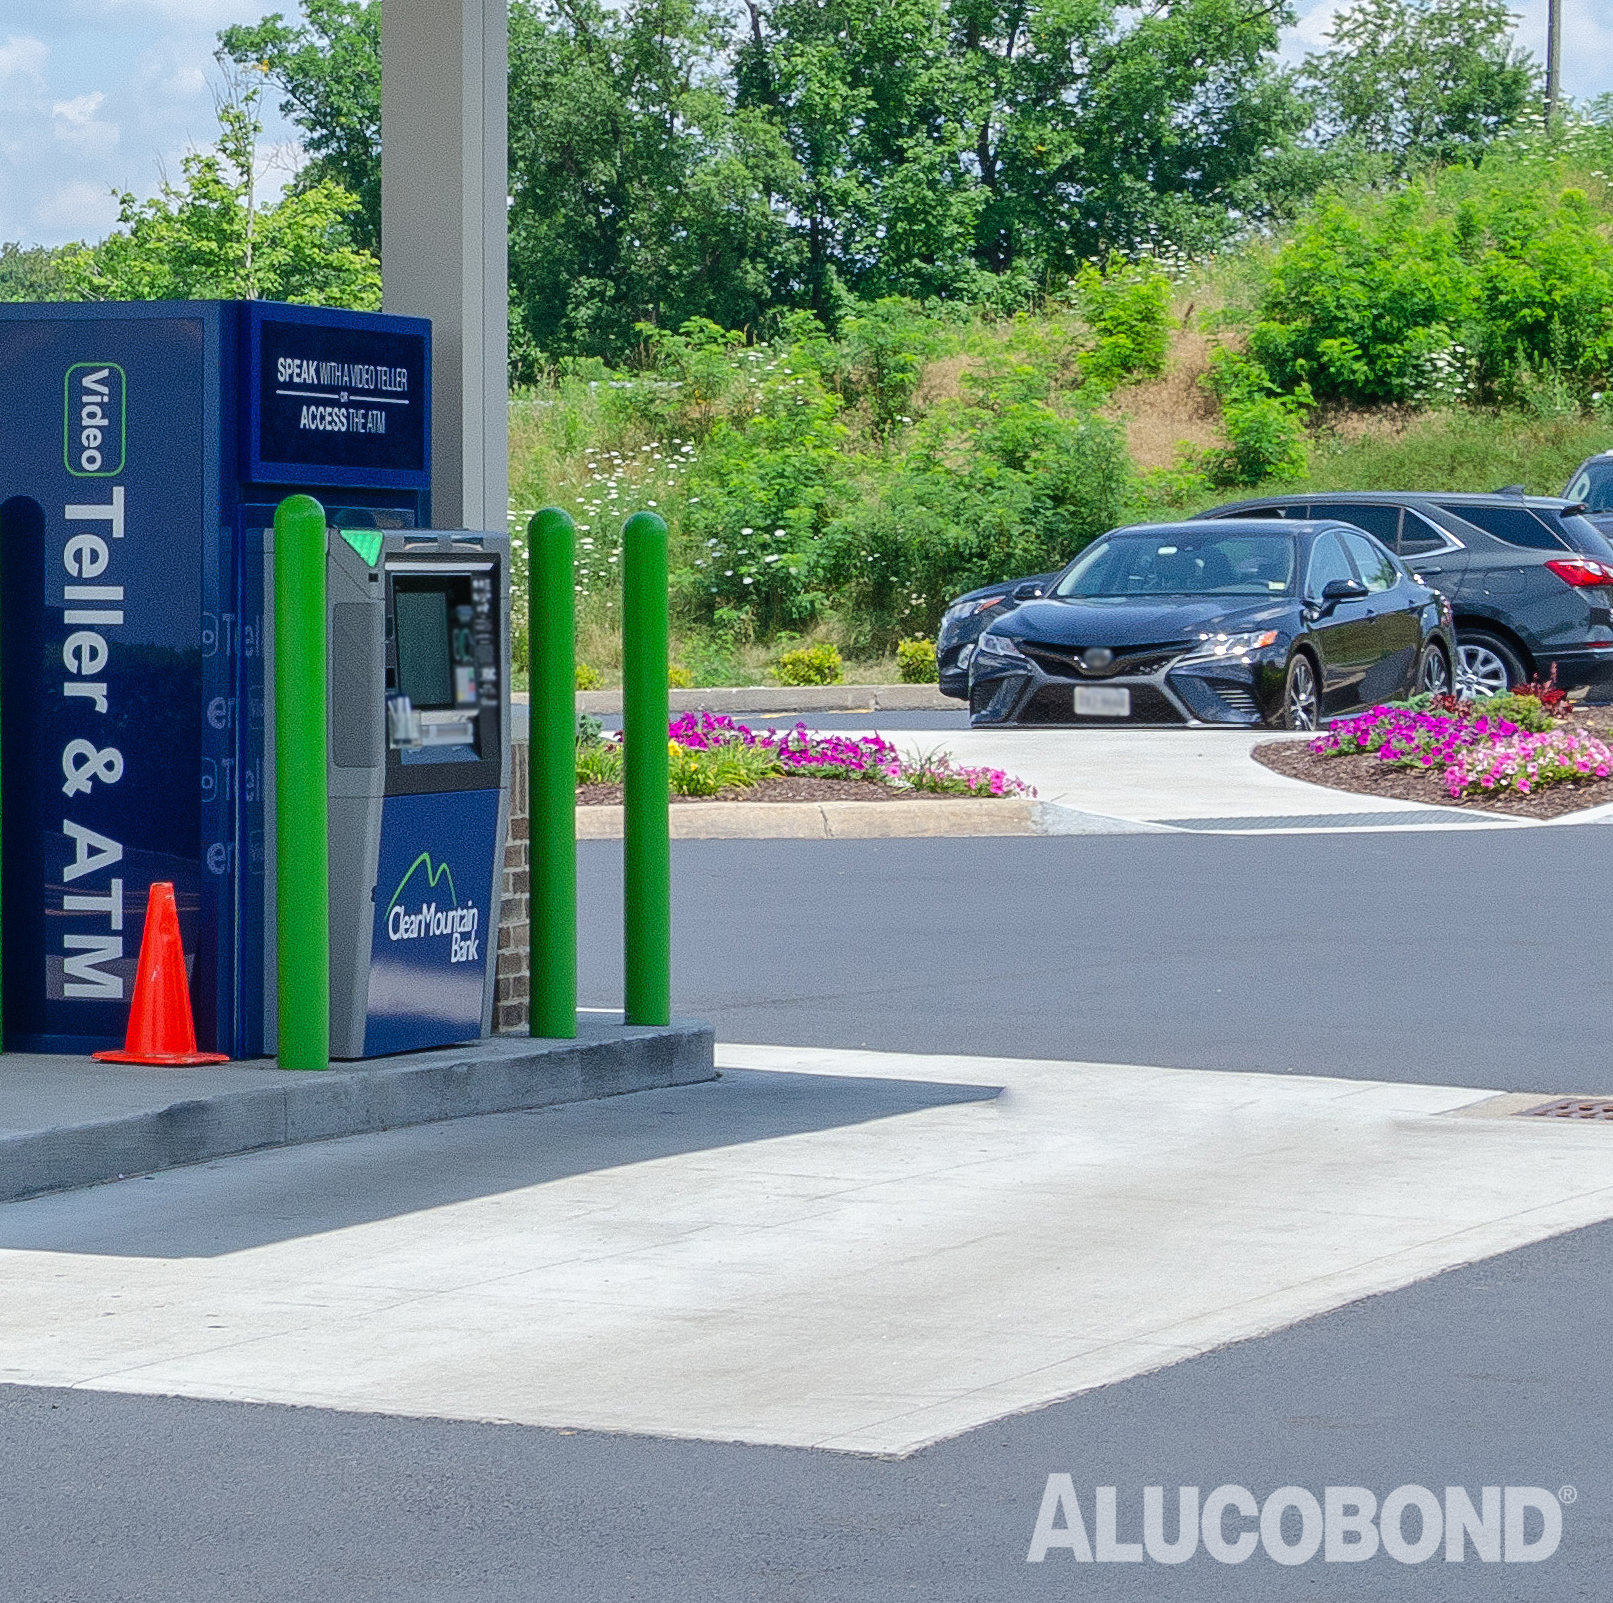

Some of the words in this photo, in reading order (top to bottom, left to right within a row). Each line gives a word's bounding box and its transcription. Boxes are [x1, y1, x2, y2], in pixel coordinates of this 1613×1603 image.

[277, 357, 318, 385] SPEAK
[319, 361, 342, 386] WITH
[342, 364, 350, 387] A
[350, 364, 375, 389] VIDEO
[376, 366, 408, 391] TELLER
[81, 368, 110, 471] Video
[299, 405, 347, 432] ACCESS
[348, 408, 365, 433] THE
[366, 410, 386, 434] ATM
[62, 486, 124, 714] Teller
[61, 738, 124, 798] &
[62, 819, 124, 1000] ATM
[388, 900, 479, 941] ClearMountain
[450, 929, 479, 963] Bank
